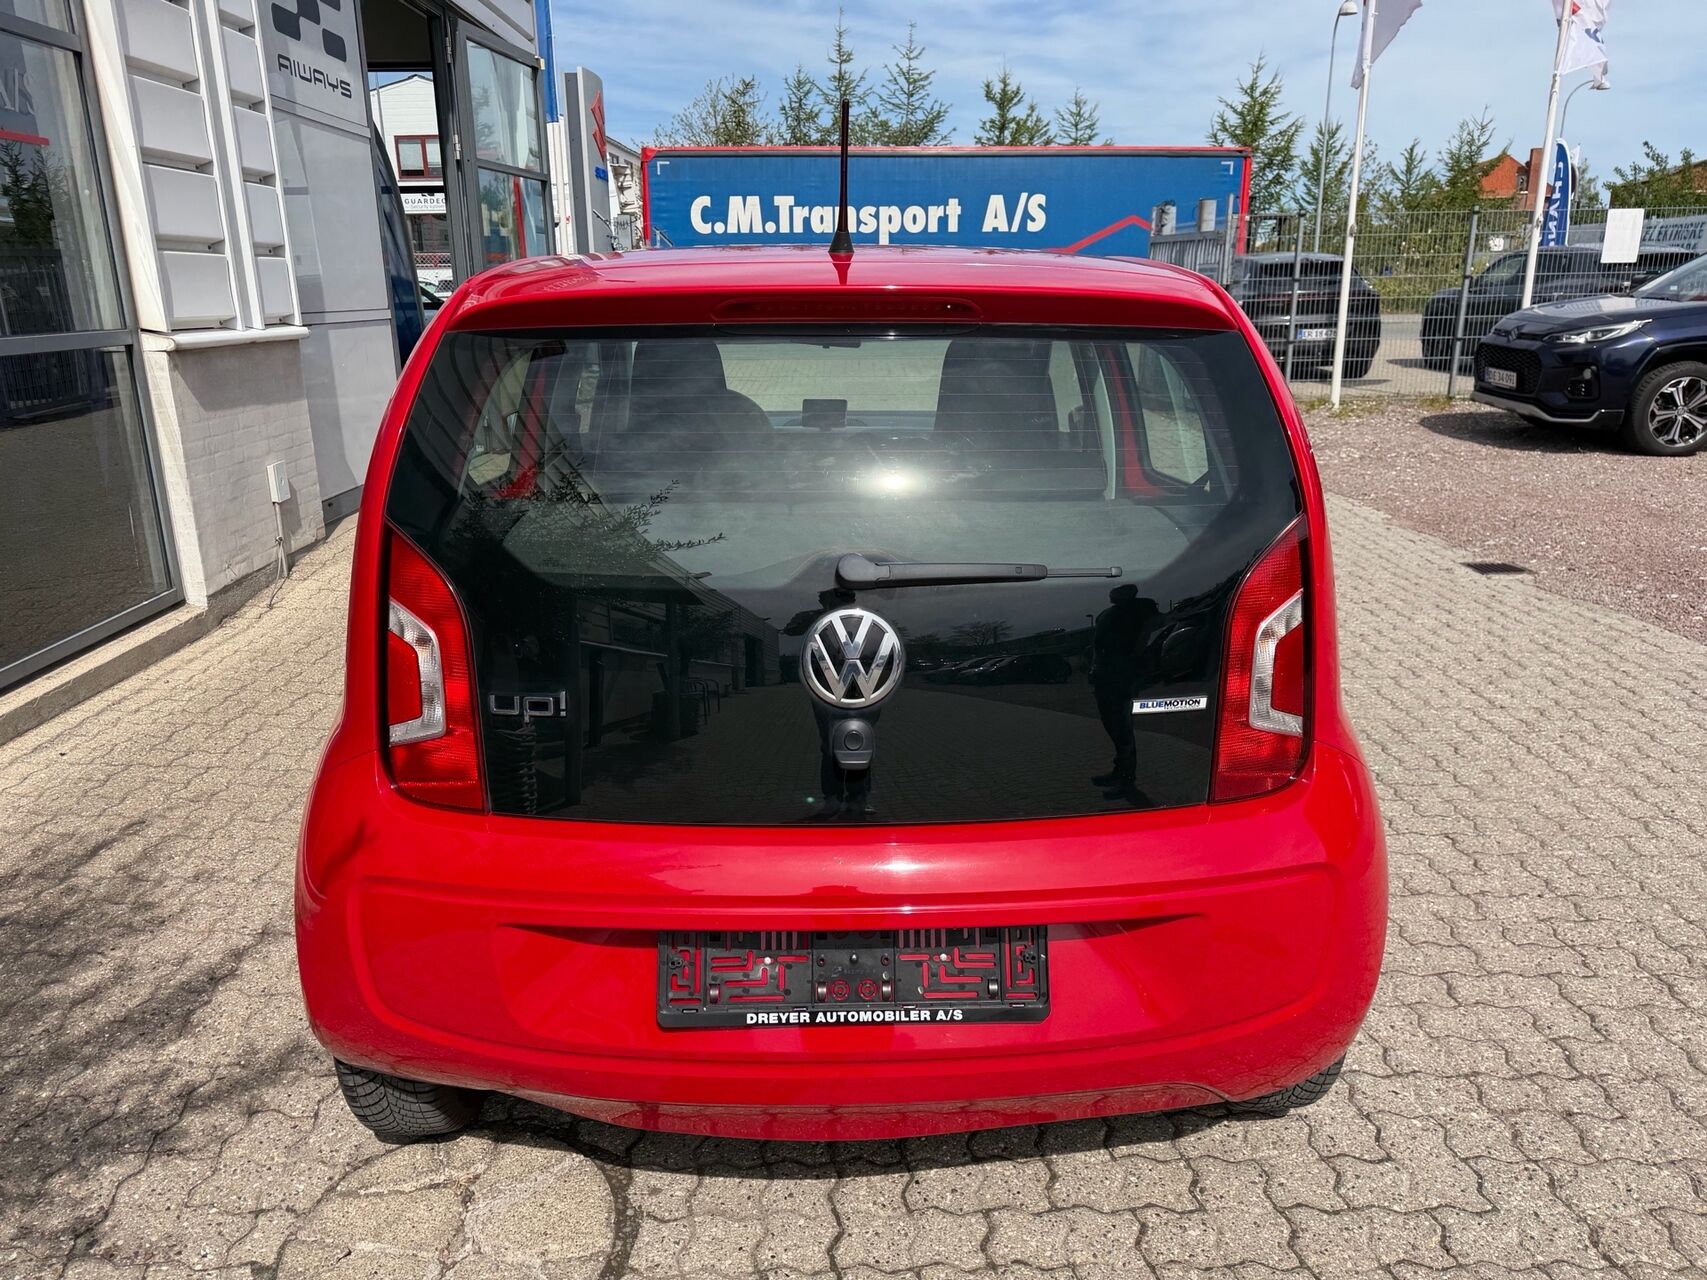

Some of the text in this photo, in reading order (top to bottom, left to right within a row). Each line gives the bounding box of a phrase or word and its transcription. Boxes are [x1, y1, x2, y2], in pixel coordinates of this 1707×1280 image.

[277, 53, 352, 99] AIWAYS
[690, 192, 1047, 245] C.M.Transport A/S
[489, 690, 567, 723] up!
[1139, 699, 1201, 709] BLUEMOTION
[746, 1009, 963, 1025] DREYER AUTOMOBILER A/S
